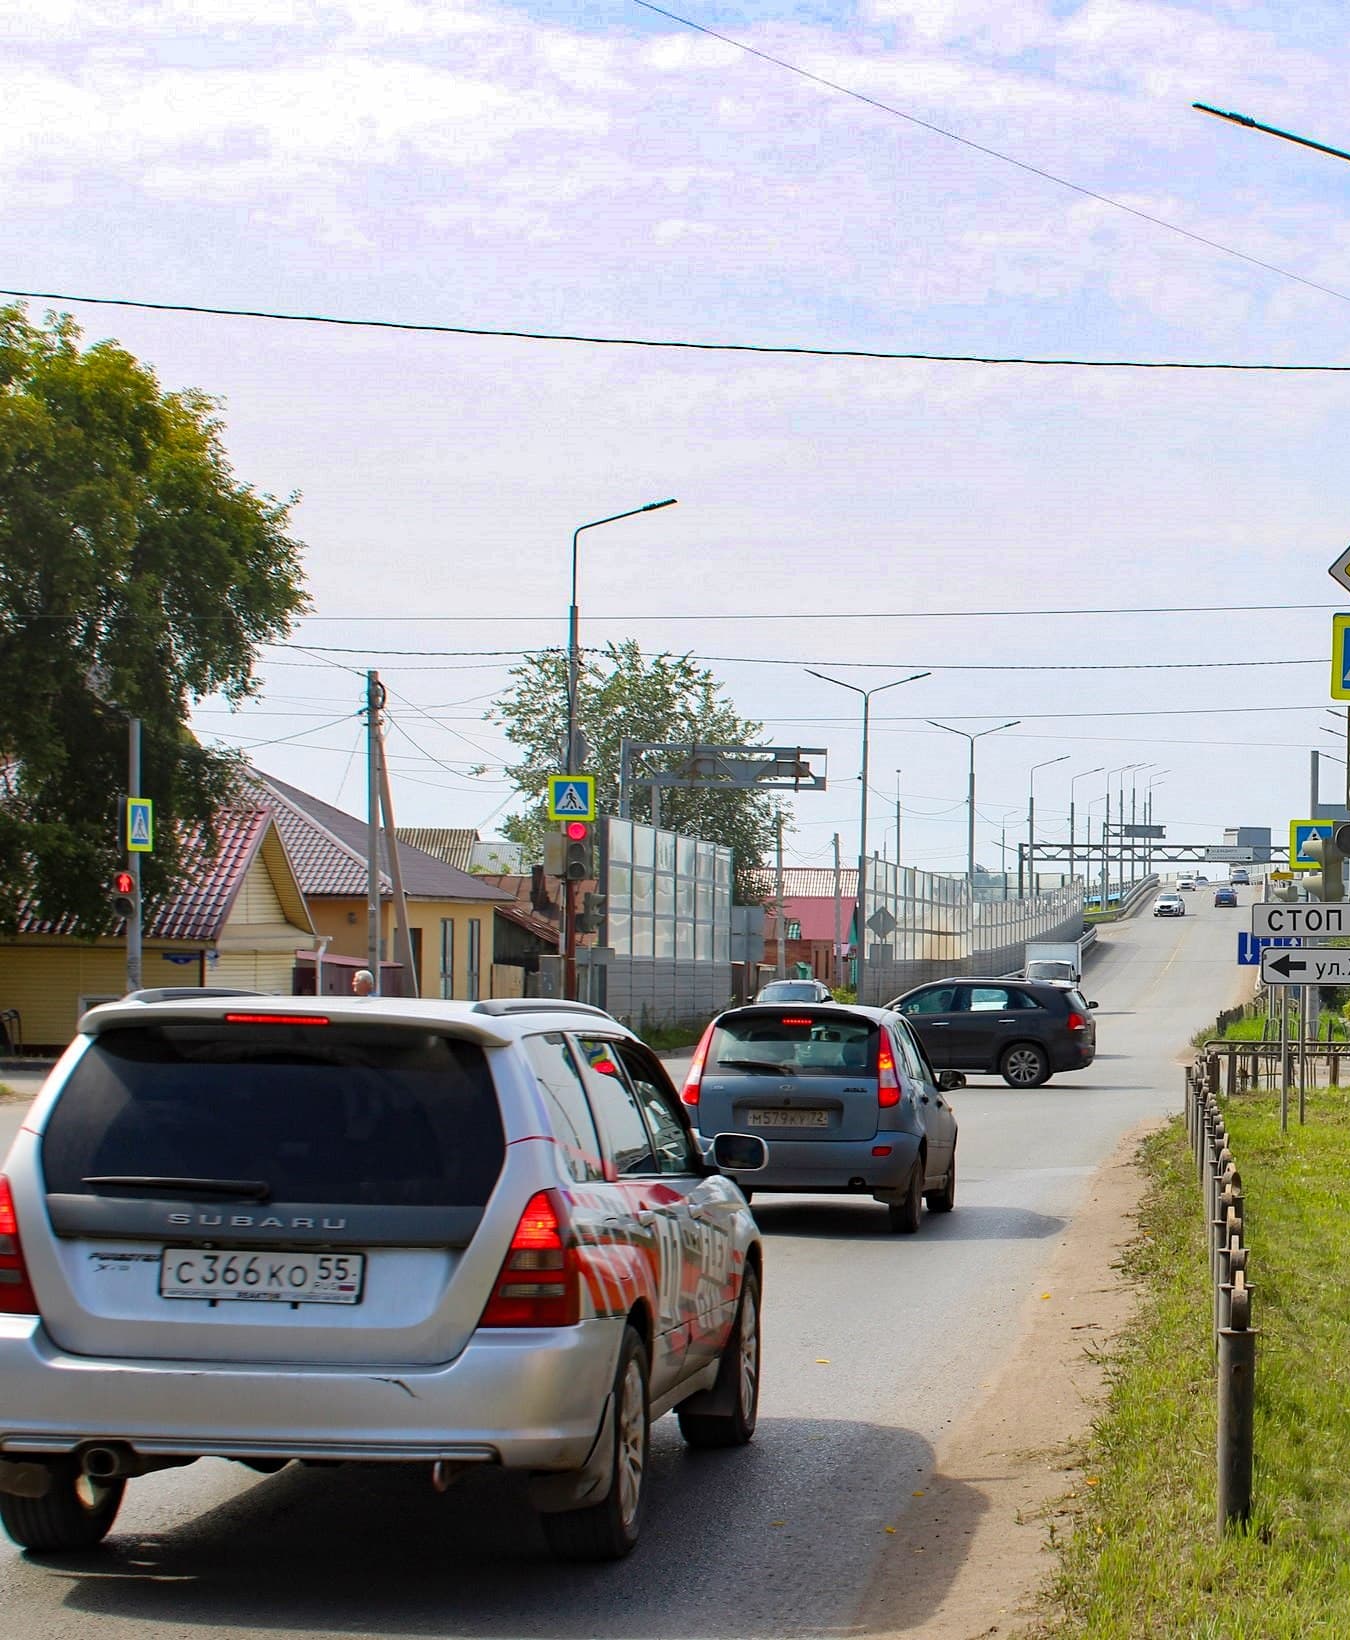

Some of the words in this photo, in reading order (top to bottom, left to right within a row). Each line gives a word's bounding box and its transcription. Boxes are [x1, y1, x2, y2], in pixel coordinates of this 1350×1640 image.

[1267, 909, 1342, 931] СТОП
[168, 1213, 347, 1229] SUBARU
[317, 1257, 350, 1281] 55
